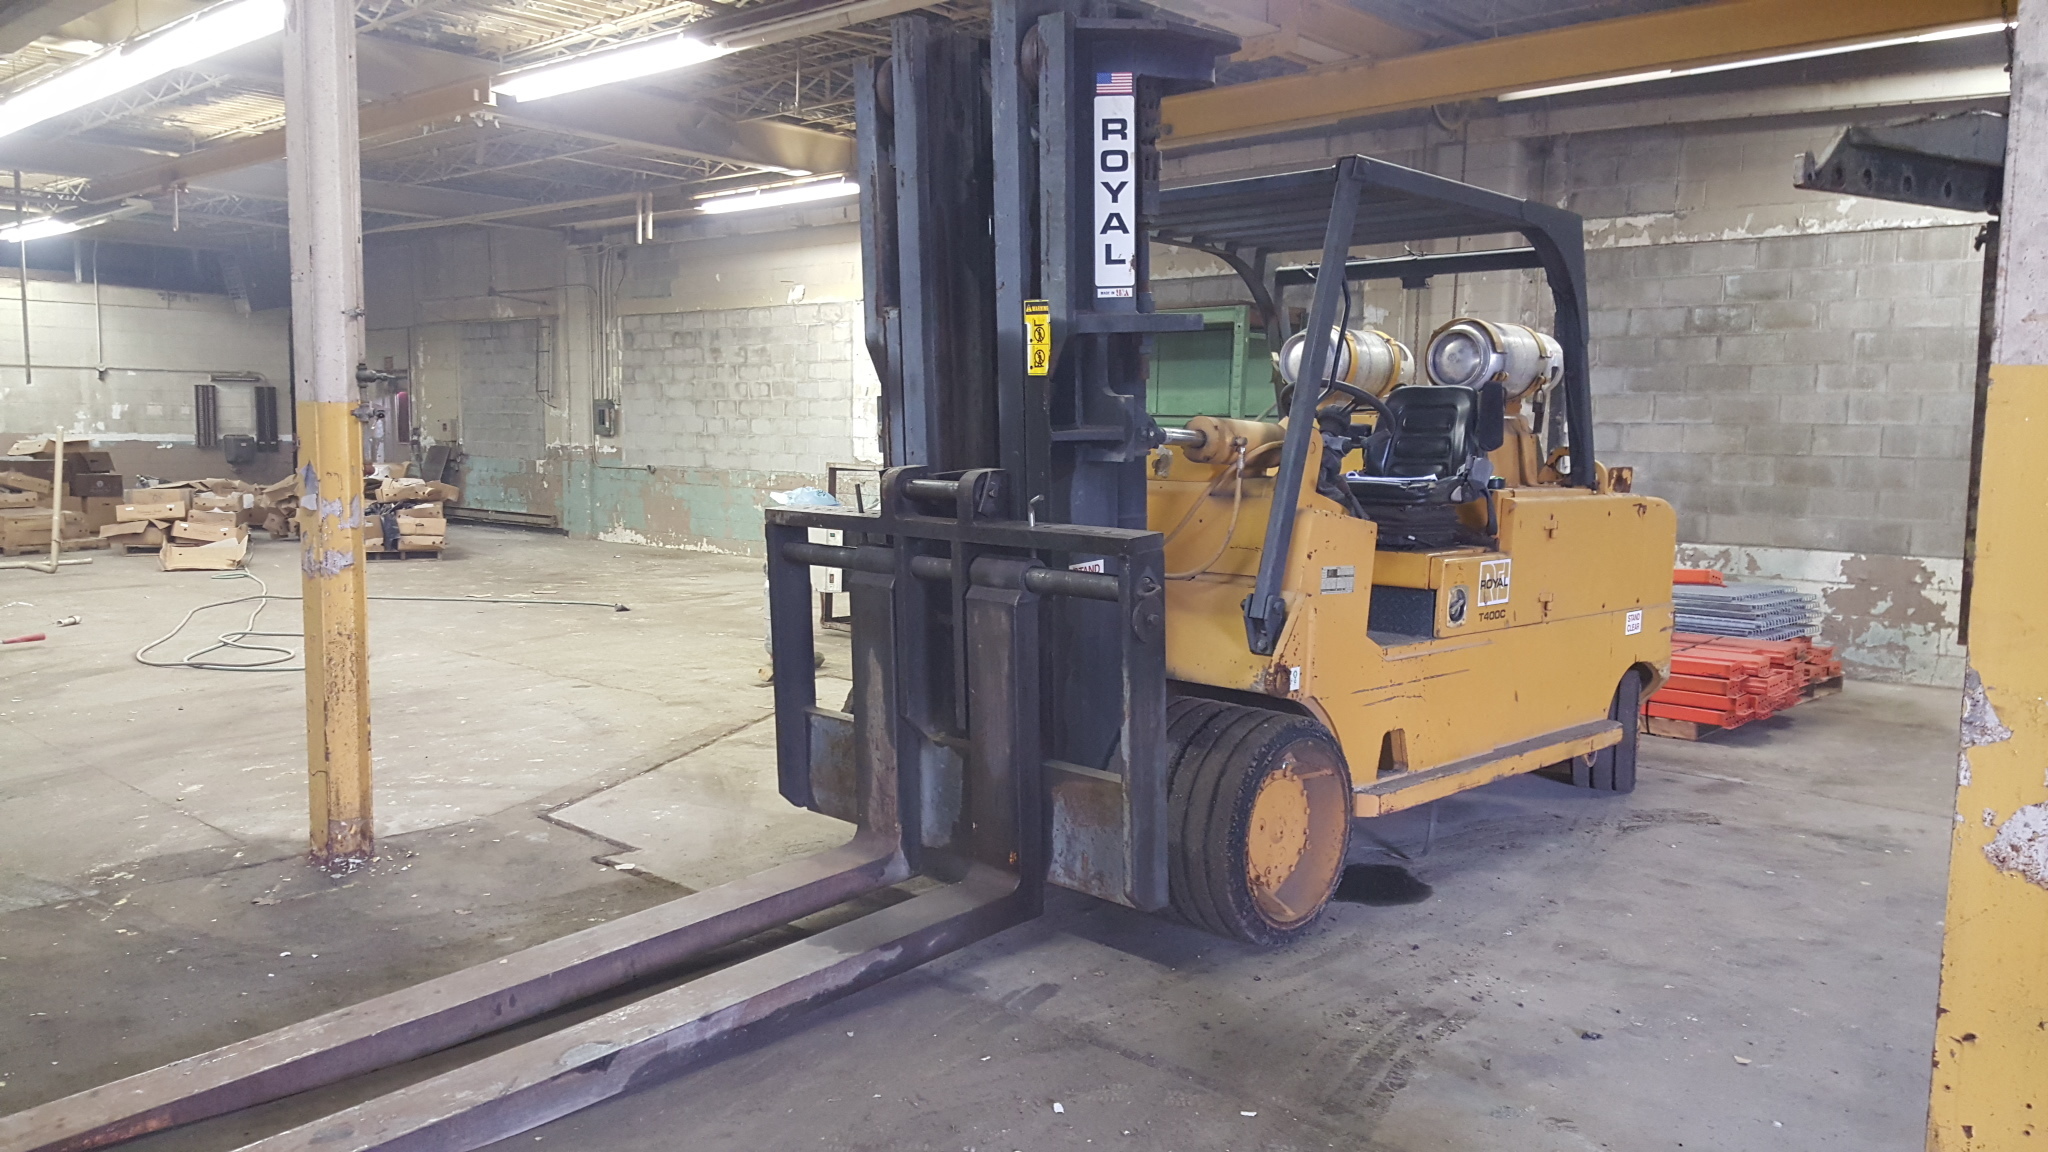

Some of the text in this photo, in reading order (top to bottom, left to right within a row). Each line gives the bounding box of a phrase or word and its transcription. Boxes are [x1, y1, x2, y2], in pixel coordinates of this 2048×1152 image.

[1099, 118, 1130, 265] ROYAL
[1480, 577, 1509, 590] ROYAL
[1478, 609, 1507, 622] T400C
[1627, 612, 1641, 622] STAND
[1626, 623, 1640, 632] CLEAR
